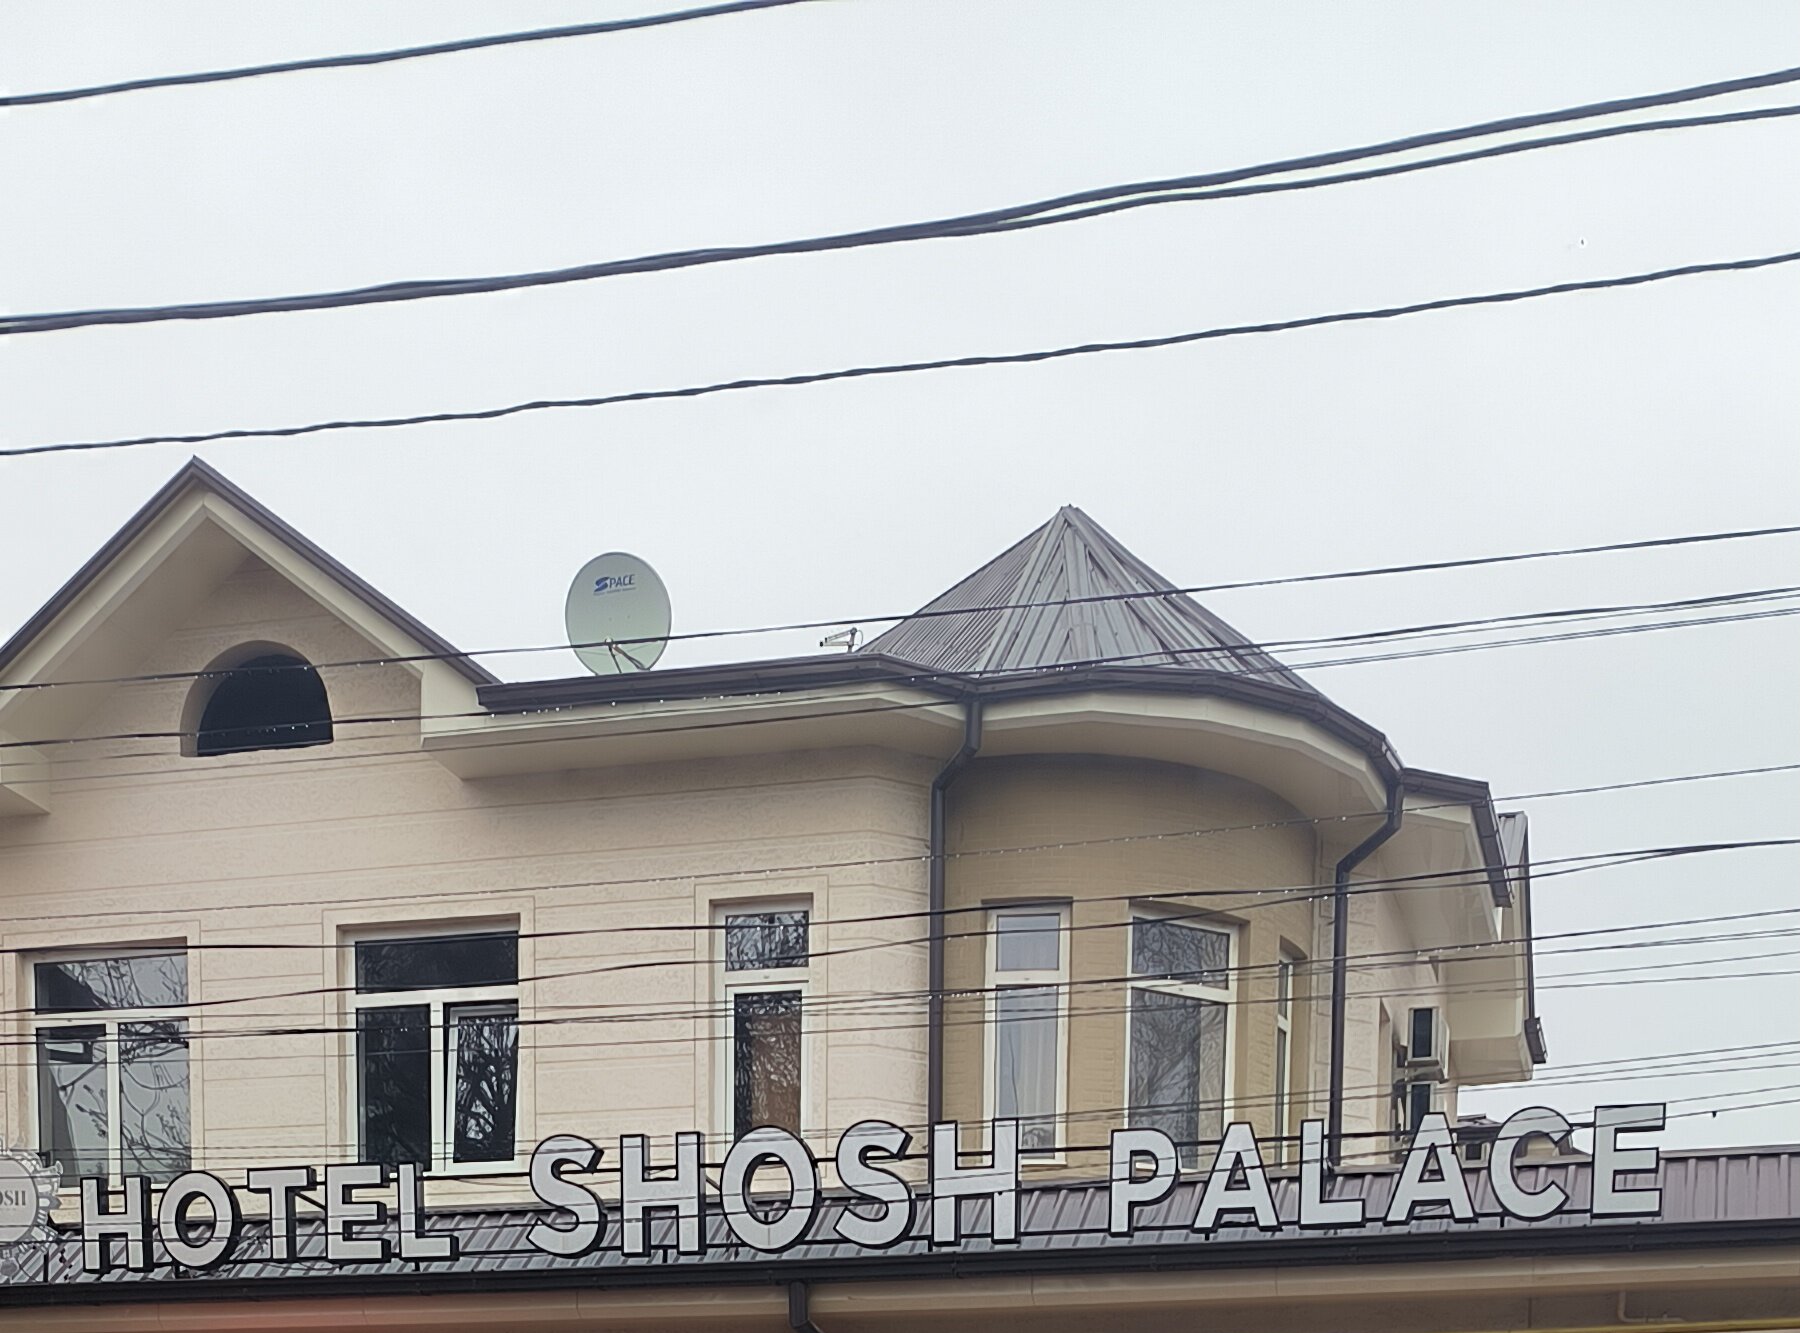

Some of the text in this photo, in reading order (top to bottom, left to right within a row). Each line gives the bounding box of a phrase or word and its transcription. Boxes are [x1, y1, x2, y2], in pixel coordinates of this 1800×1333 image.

[594, 574, 635, 592] SPACE
[81, 1103, 1667, 1273] HOTEL SHOSH PALACE
